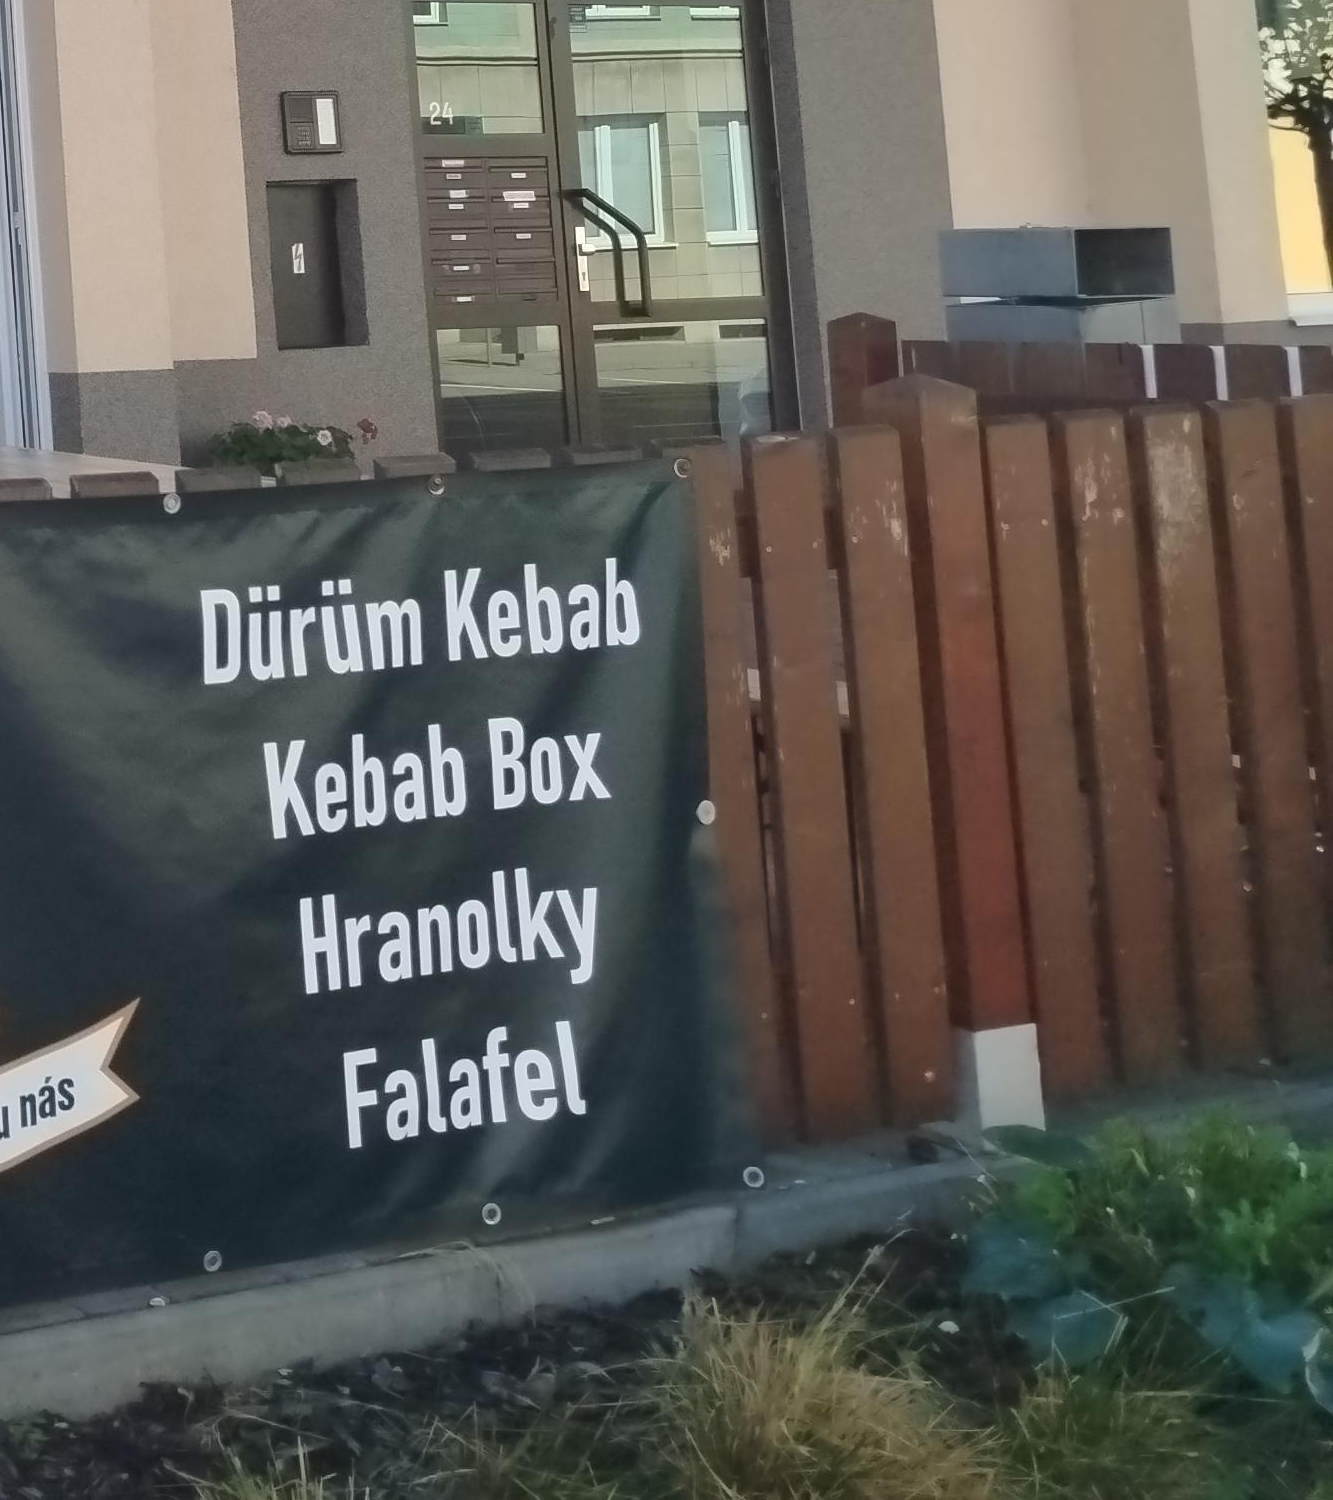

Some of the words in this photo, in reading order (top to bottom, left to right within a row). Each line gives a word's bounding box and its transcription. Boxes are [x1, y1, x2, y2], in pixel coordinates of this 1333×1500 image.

[429, 101, 454, 126] 24
[199, 578, 423, 686] Dürüm
[443, 557, 642, 662] Kebab
[263, 723, 467, 840] Kebab
[487, 717, 612, 811] Box
[298, 866, 599, 995] Hranolky
[18, 1075, 77, 1129] nás
[342, 1020, 587, 1150] Falafel
